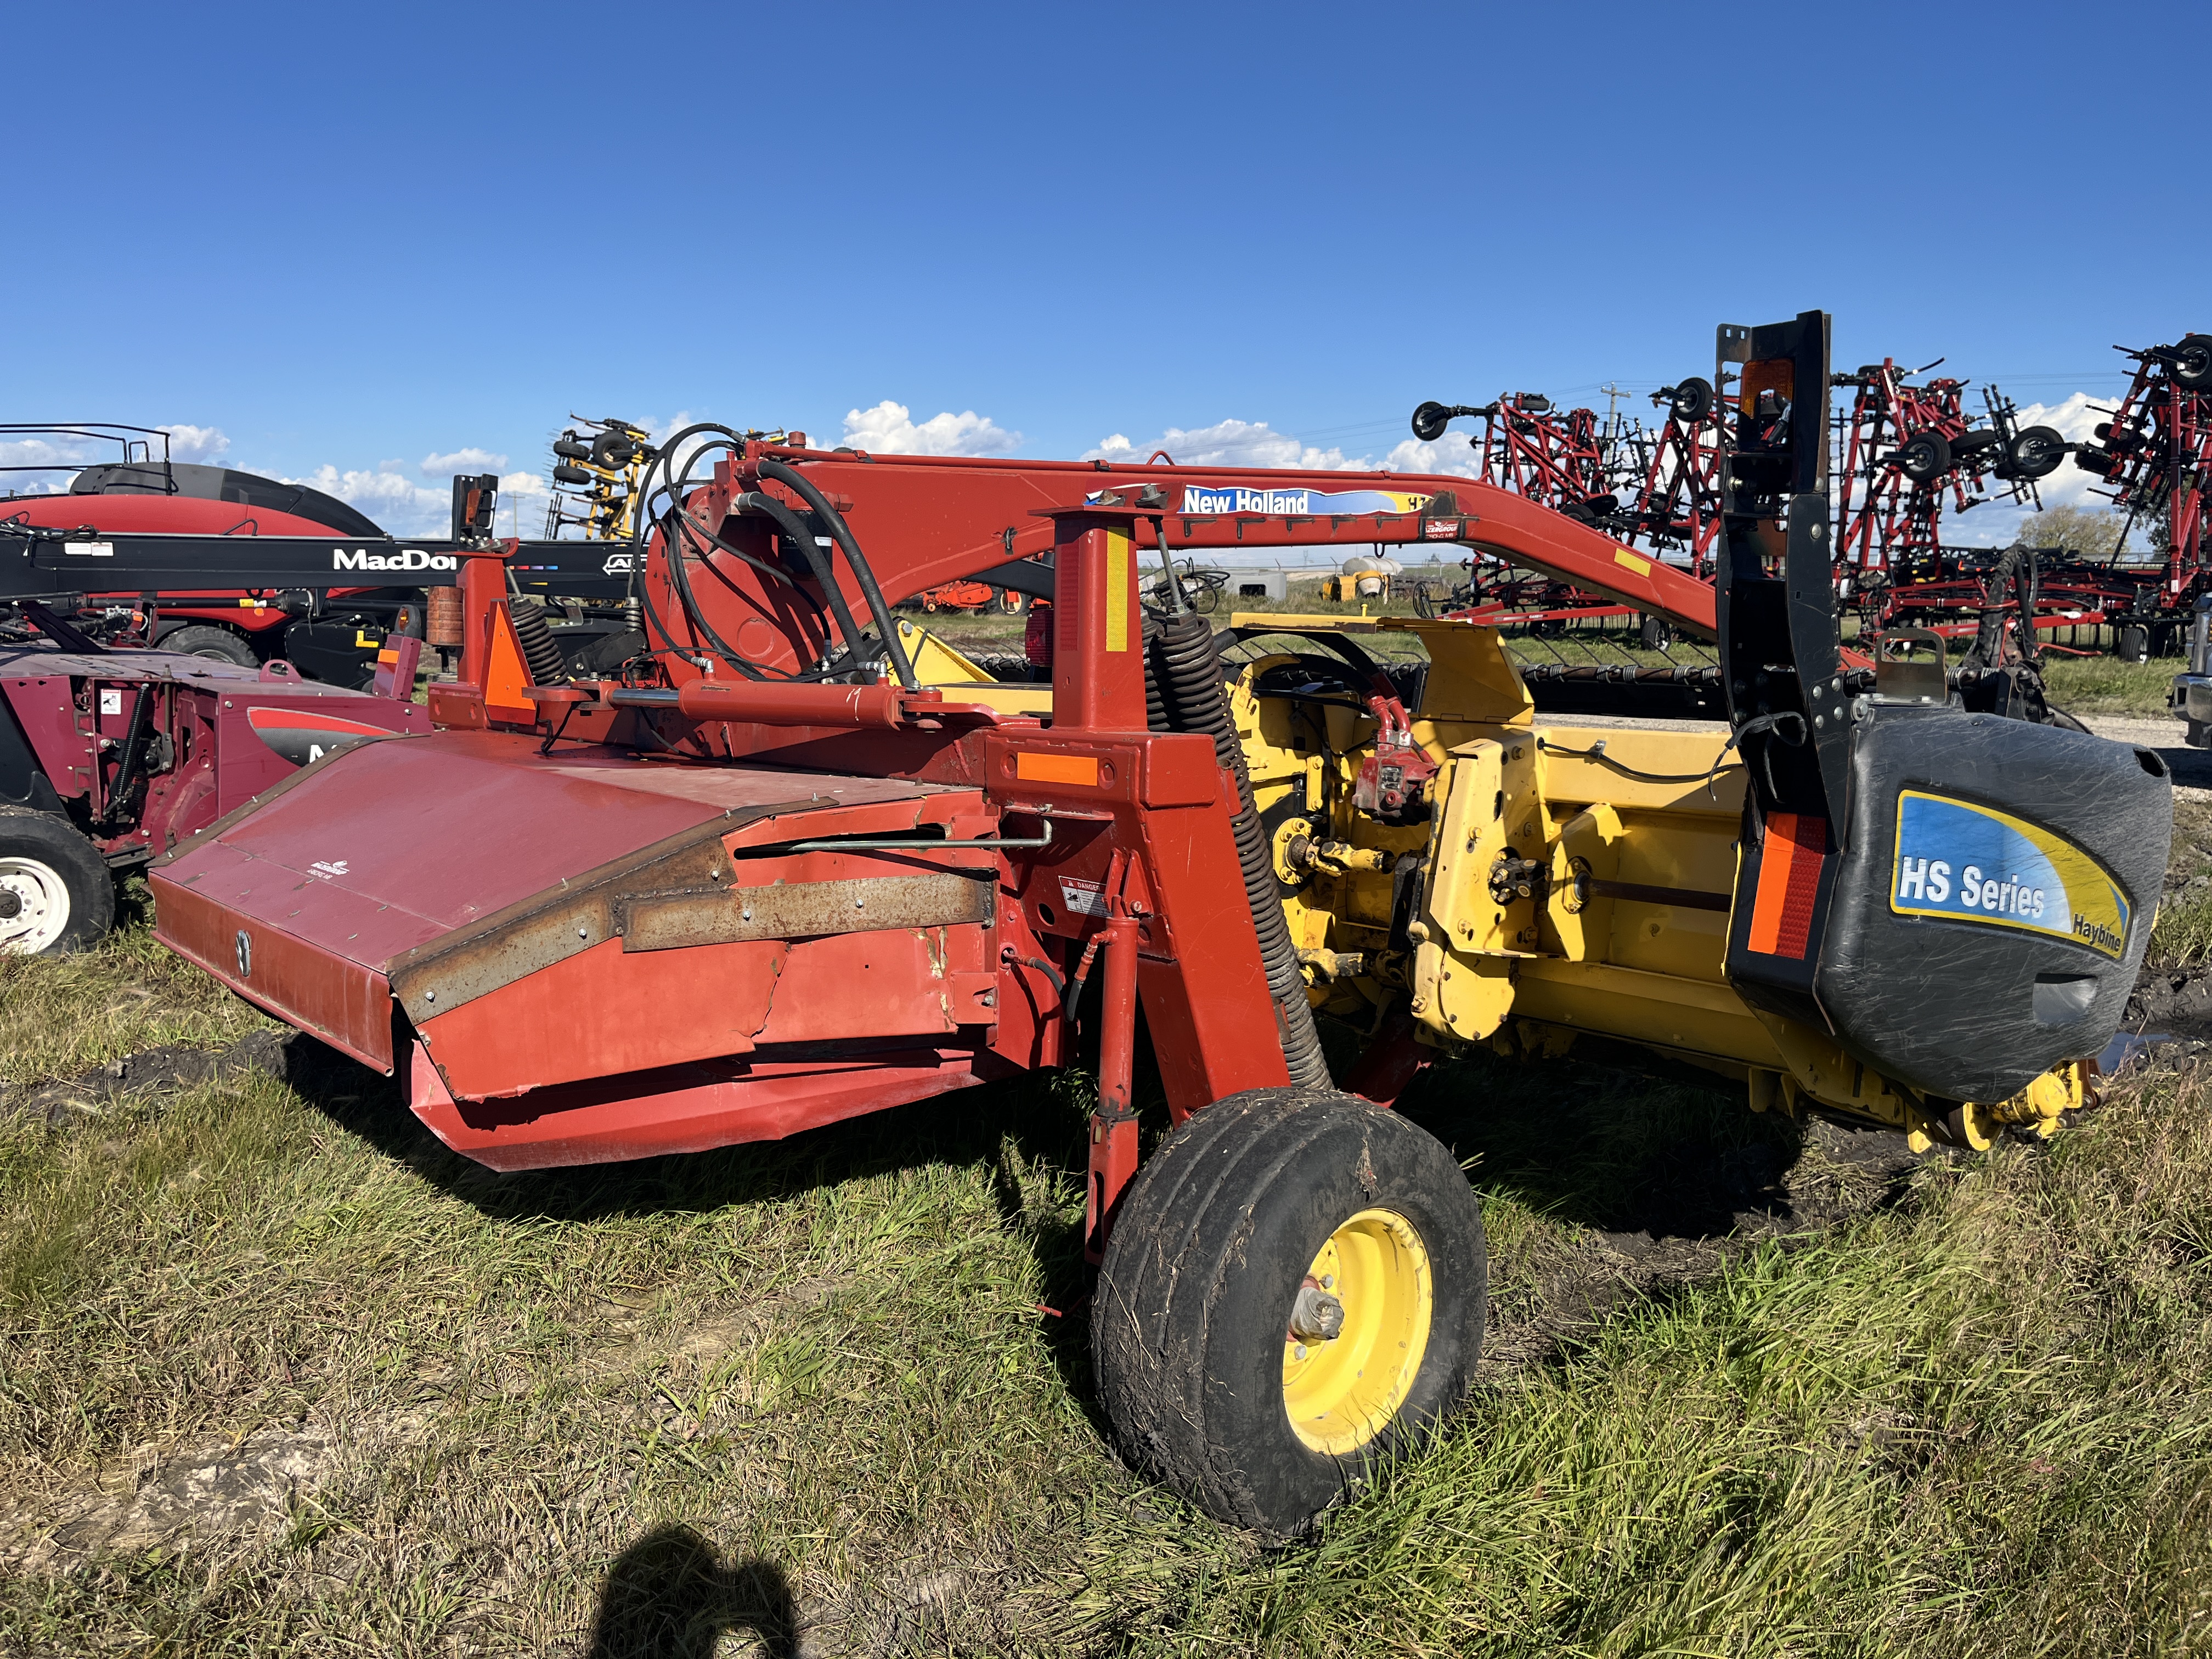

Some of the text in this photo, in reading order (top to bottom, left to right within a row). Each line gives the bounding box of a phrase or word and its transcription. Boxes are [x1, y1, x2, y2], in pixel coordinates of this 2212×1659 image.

[1184, 489, 1308, 514] New Holland
[1077, 882, 1101, 891] DANGER
[1899, 856, 2045, 918] HS Series
[2072, 913, 2121, 952] Haybine
